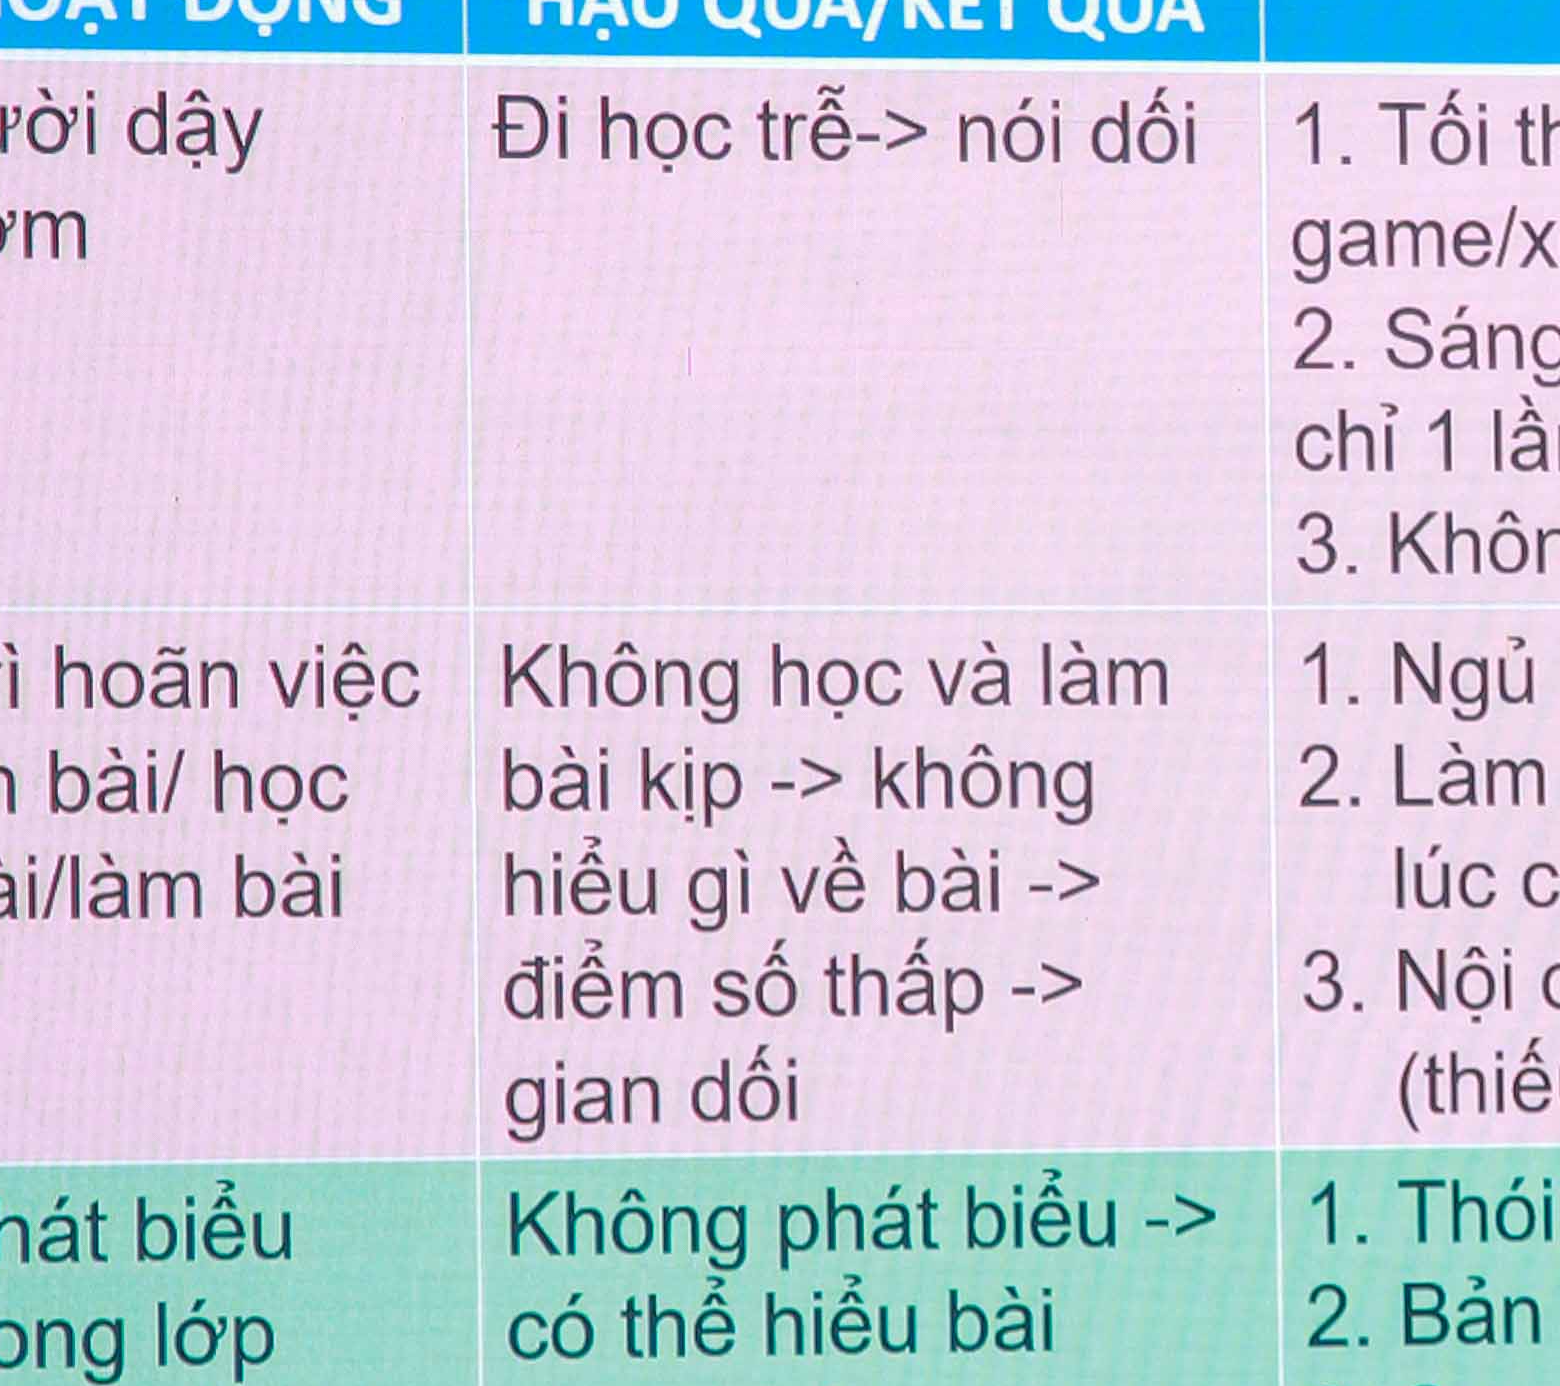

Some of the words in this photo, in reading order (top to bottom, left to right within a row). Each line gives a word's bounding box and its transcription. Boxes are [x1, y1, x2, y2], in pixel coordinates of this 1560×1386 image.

[125, 87, 265, 177] dậy
[489, 92, 570, 162] Đi
[598, 93, 734, 175] học
[754, 82, 930, 164] trễ->
[957, 95, 1063, 165] nói
[1089, 84, 1197, 166] dối
[1294, 99, 1353, 167] 1.
[1376, 86, 1490, 168] Tối
[135, 1177, 294, 1264] biểu
[155, 1296, 277, 1385] lớp
